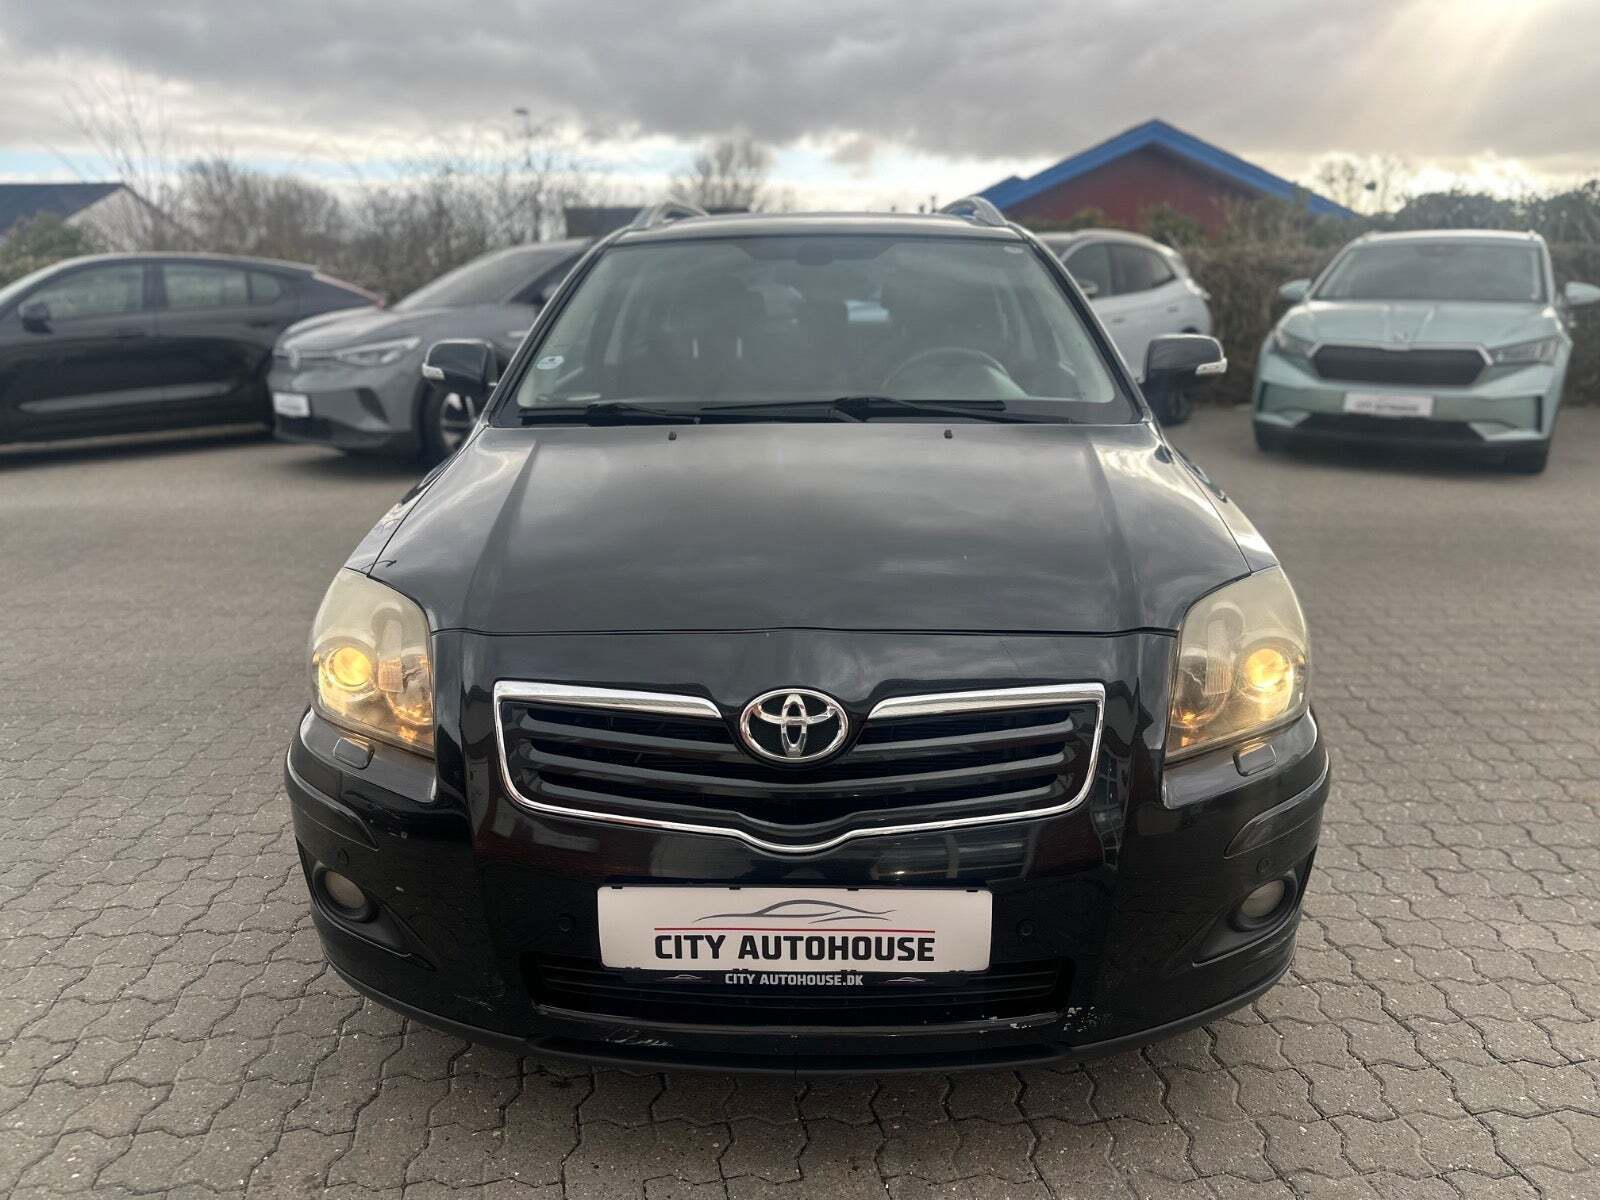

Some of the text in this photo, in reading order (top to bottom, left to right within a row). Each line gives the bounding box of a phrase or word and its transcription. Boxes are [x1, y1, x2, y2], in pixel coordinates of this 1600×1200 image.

[655, 934, 935, 961] CITY AUTOHOUSE
[725, 973, 863, 986] CITY AUTOHOUSE.DK
